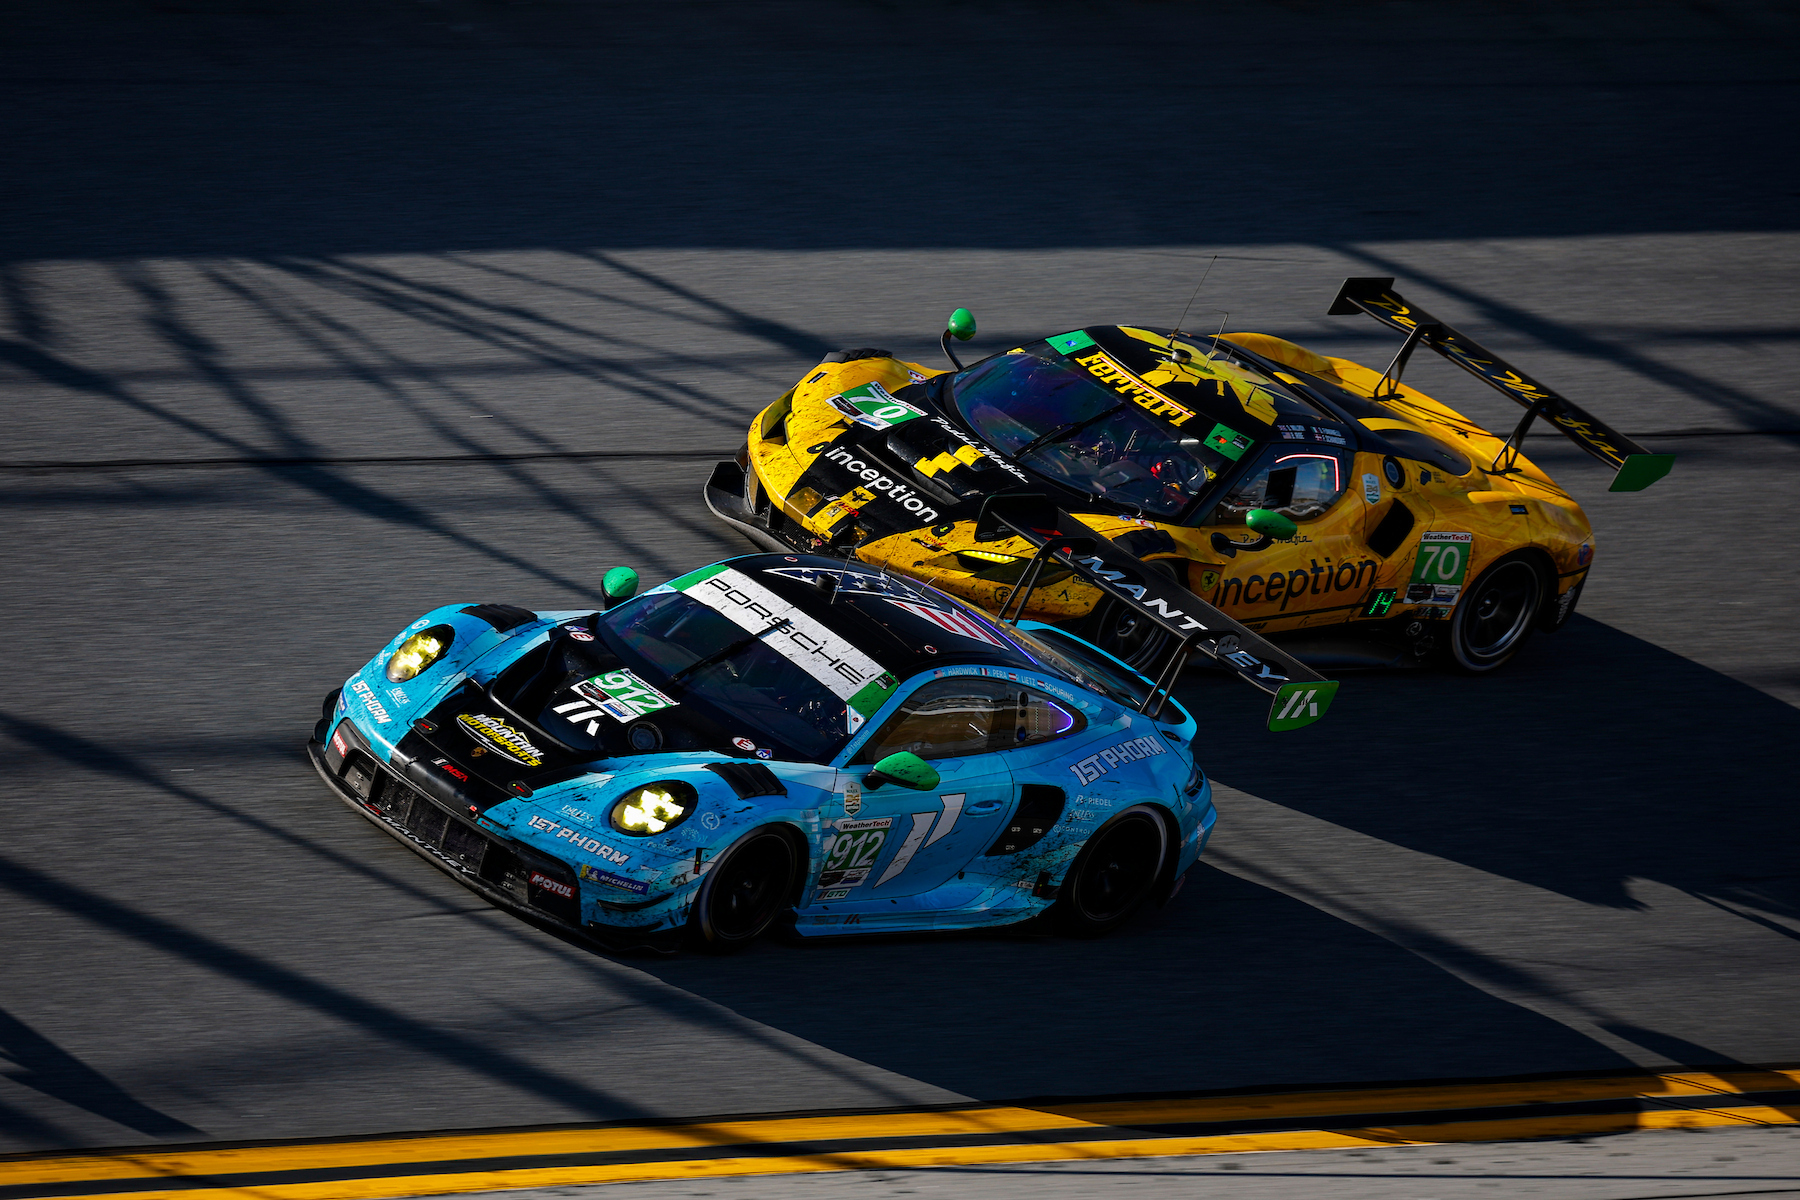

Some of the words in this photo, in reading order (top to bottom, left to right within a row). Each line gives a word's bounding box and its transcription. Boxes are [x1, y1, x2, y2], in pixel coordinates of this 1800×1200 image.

[849, 387, 908, 419] 70
[1075, 351, 1197, 427] Ferrari
[825, 446, 939, 523] inception
[1420, 545, 1461, 580] 70
[1211, 557, 1378, 612] inception
[705, 578, 865, 685] PORSCHE
[1078, 555, 1290, 683] MANTEY
[947, 667, 979, 677] HARDWICK
[993, 669, 1008, 679] PERA
[1021, 675, 1037, 687] LIETZ
[1044, 682, 1074, 702] SCHURING
[359, 688, 393, 724] PHORM
[594, 672, 666, 715] 912
[457, 714, 543, 767] MOTORSPORTS
[473, 714, 545, 758] MOUNTAIN
[1069, 753, 1109, 788] 1ST
[1099, 735, 1168, 769] PHORM
[527, 814, 561, 834] 1ST
[556, 827, 630, 867] PHORM
[843, 820, 890, 830] WeatherTech
[827, 830, 885, 870] 912
[531, 874, 572, 898] MOTUL
[600, 874, 644, 892] MICHELIN
